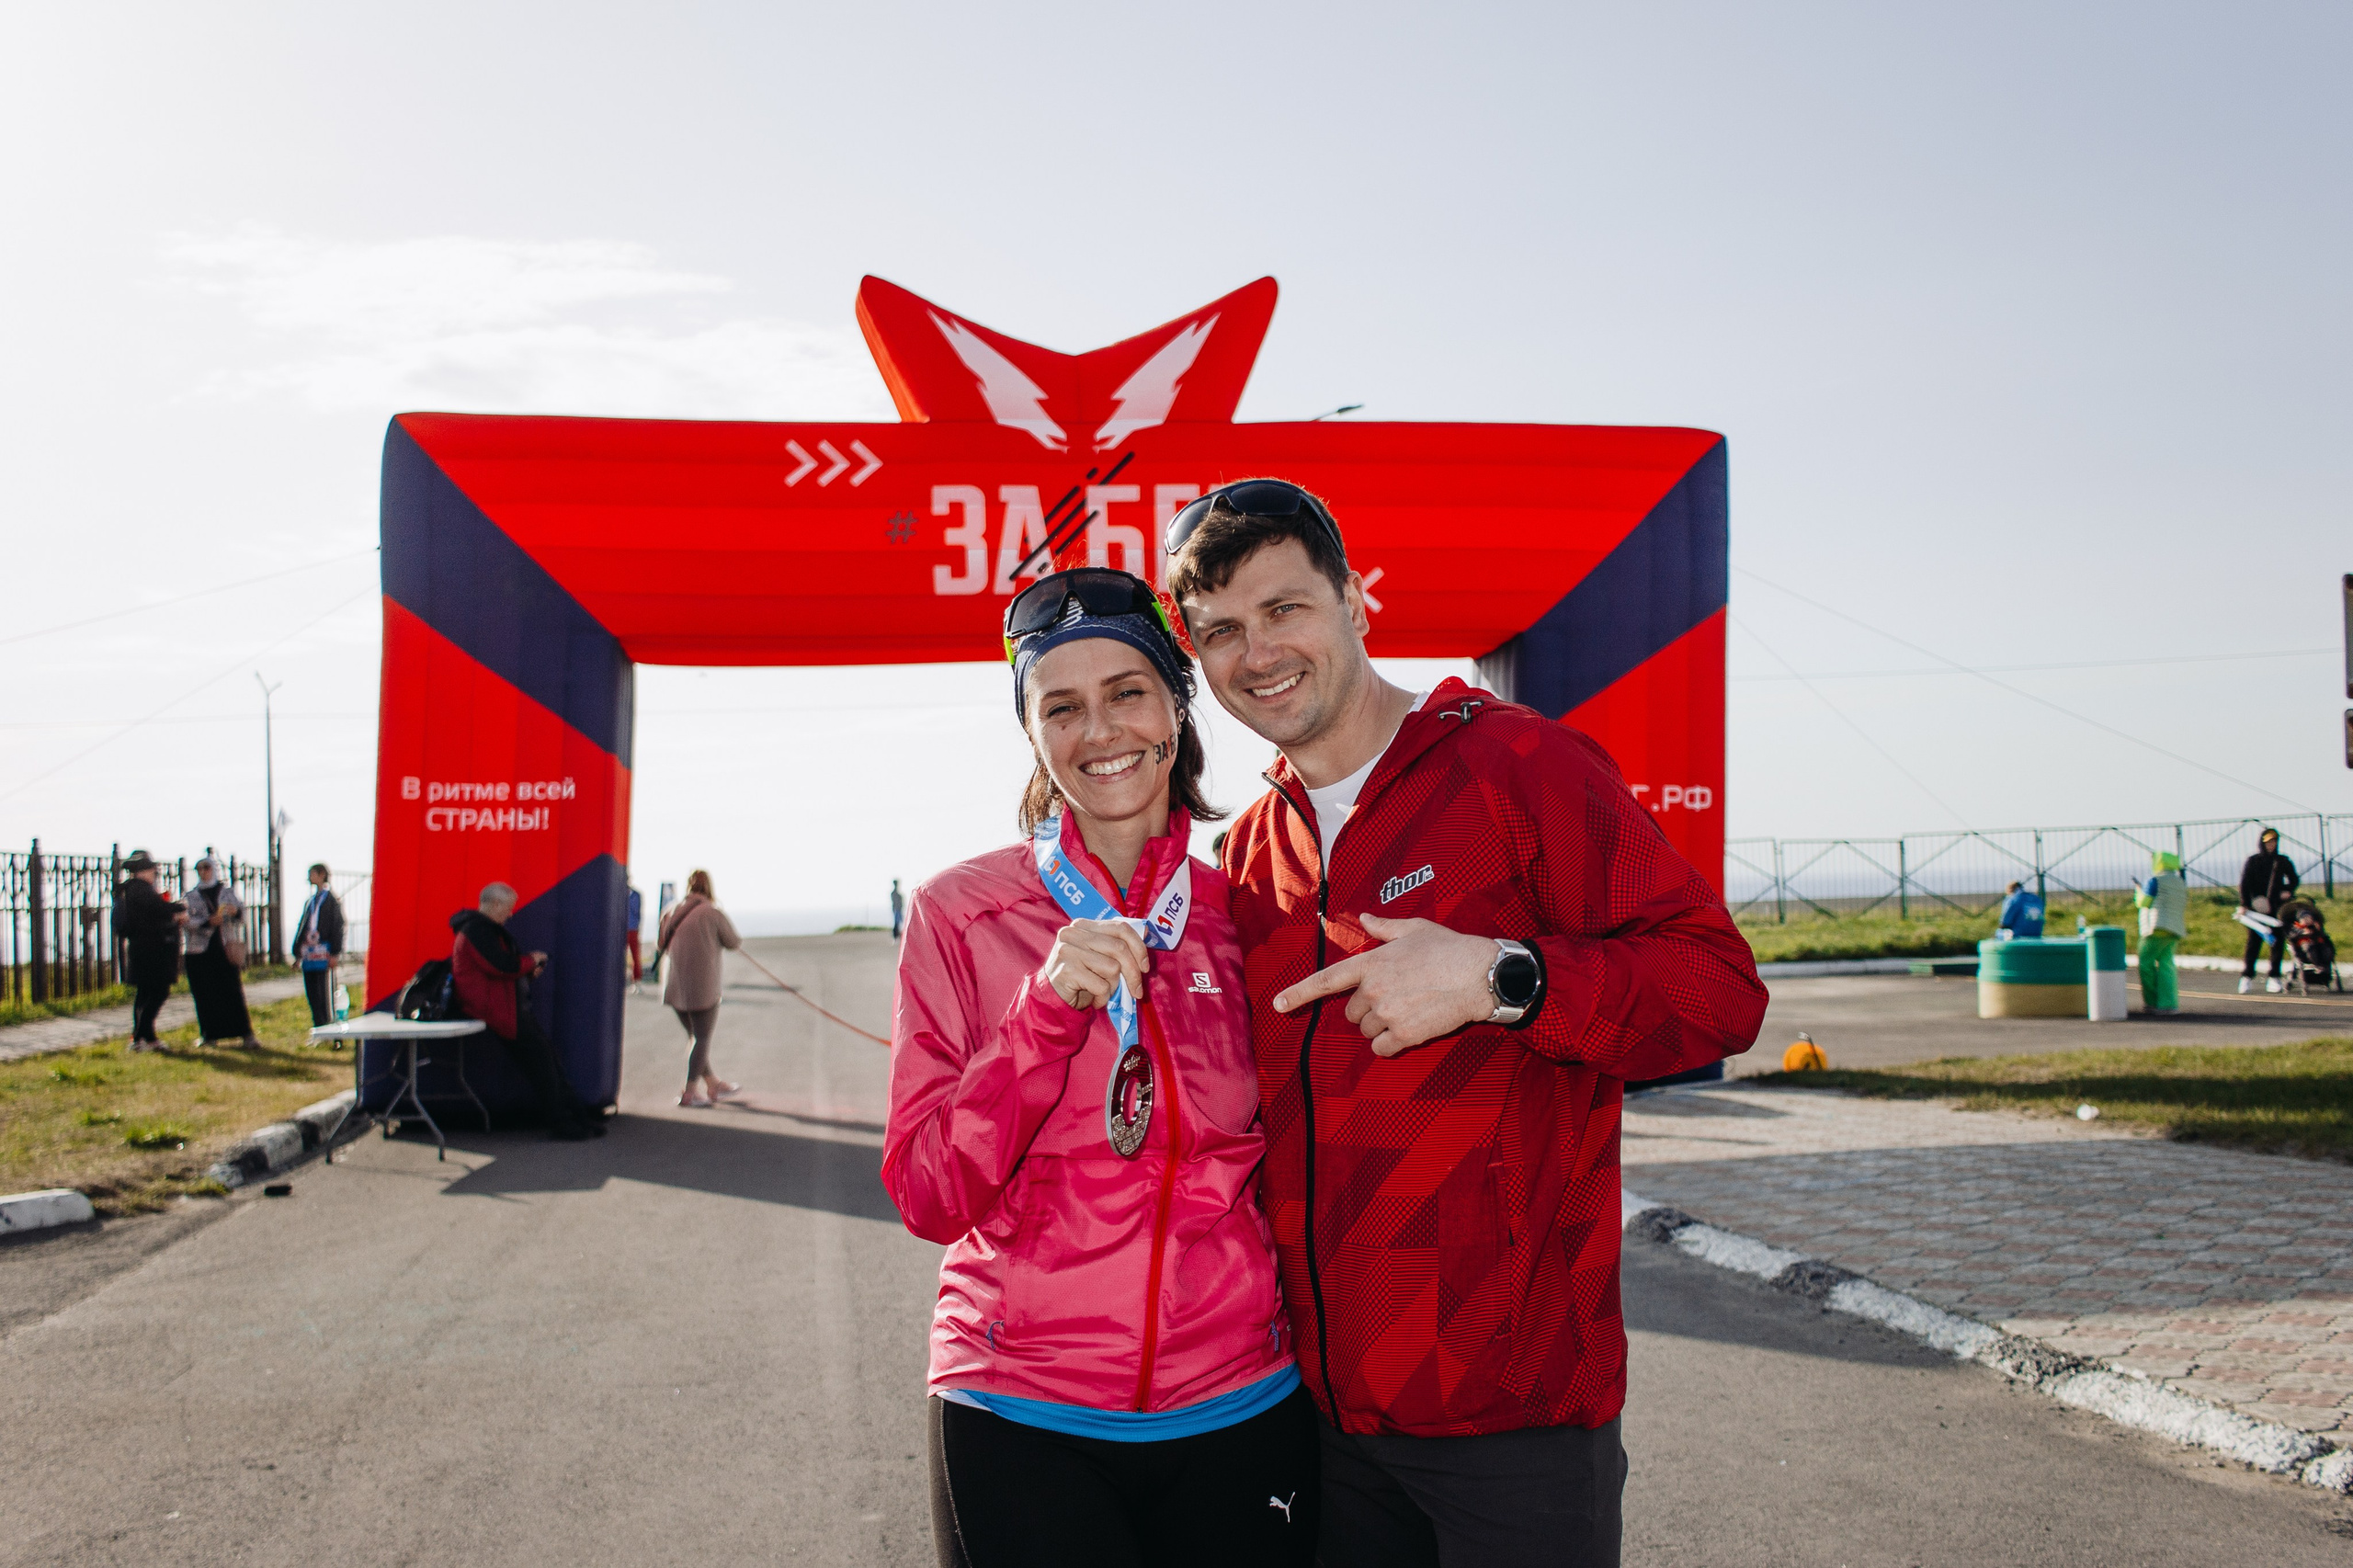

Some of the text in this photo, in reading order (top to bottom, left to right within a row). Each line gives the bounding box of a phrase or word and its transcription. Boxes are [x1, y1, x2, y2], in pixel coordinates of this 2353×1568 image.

[401, 776, 576, 803] В ритме всей
[426, 806, 550, 832] СТРАНЫ!
[1054, 870, 1086, 905] ПСБ
[1165, 892, 1184, 921] ПСБ
